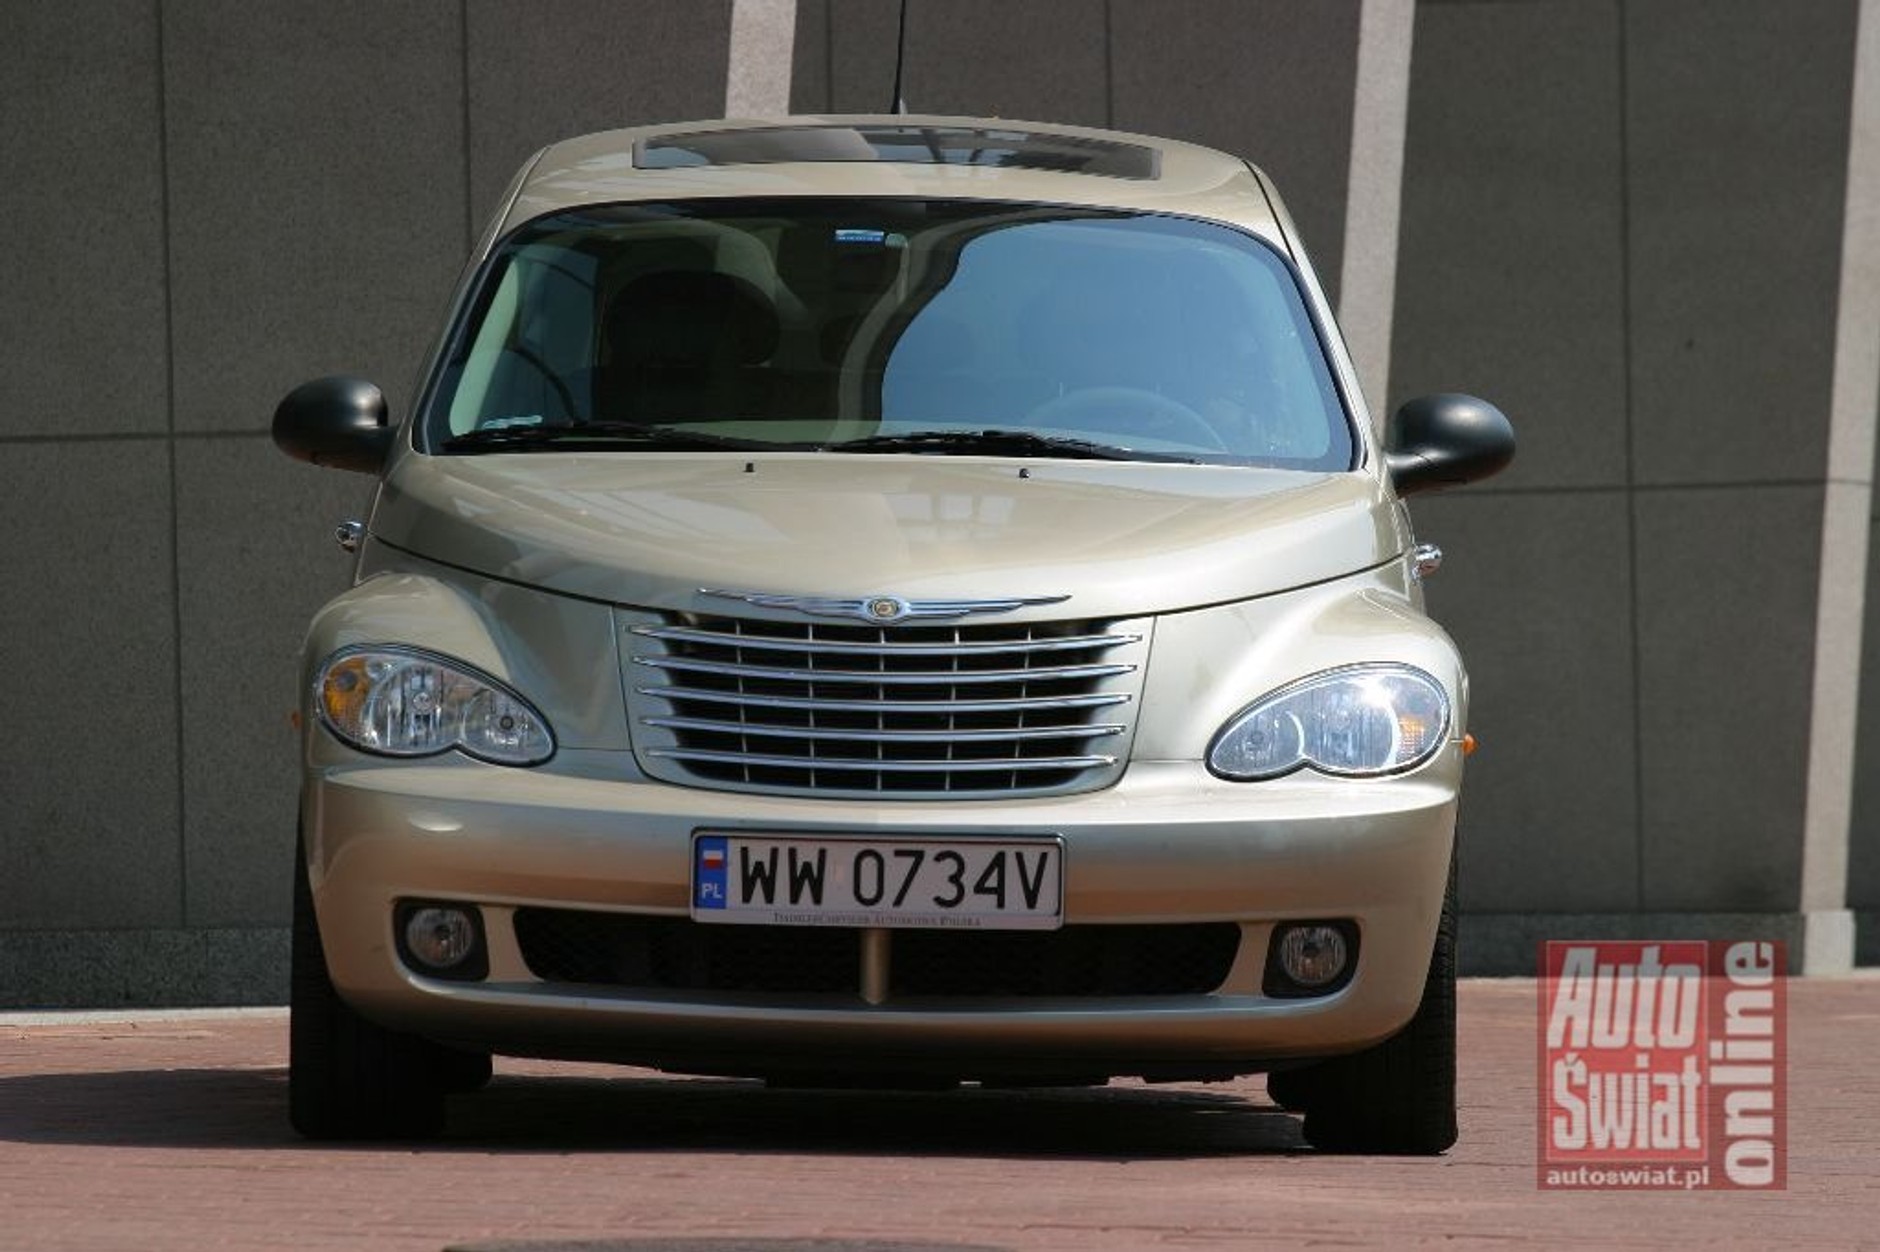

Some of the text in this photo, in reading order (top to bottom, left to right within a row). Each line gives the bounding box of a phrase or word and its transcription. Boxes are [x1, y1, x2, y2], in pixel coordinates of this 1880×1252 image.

[702, 883, 723, 899] PL
[740, 847, 1048, 909] WW 0734V
